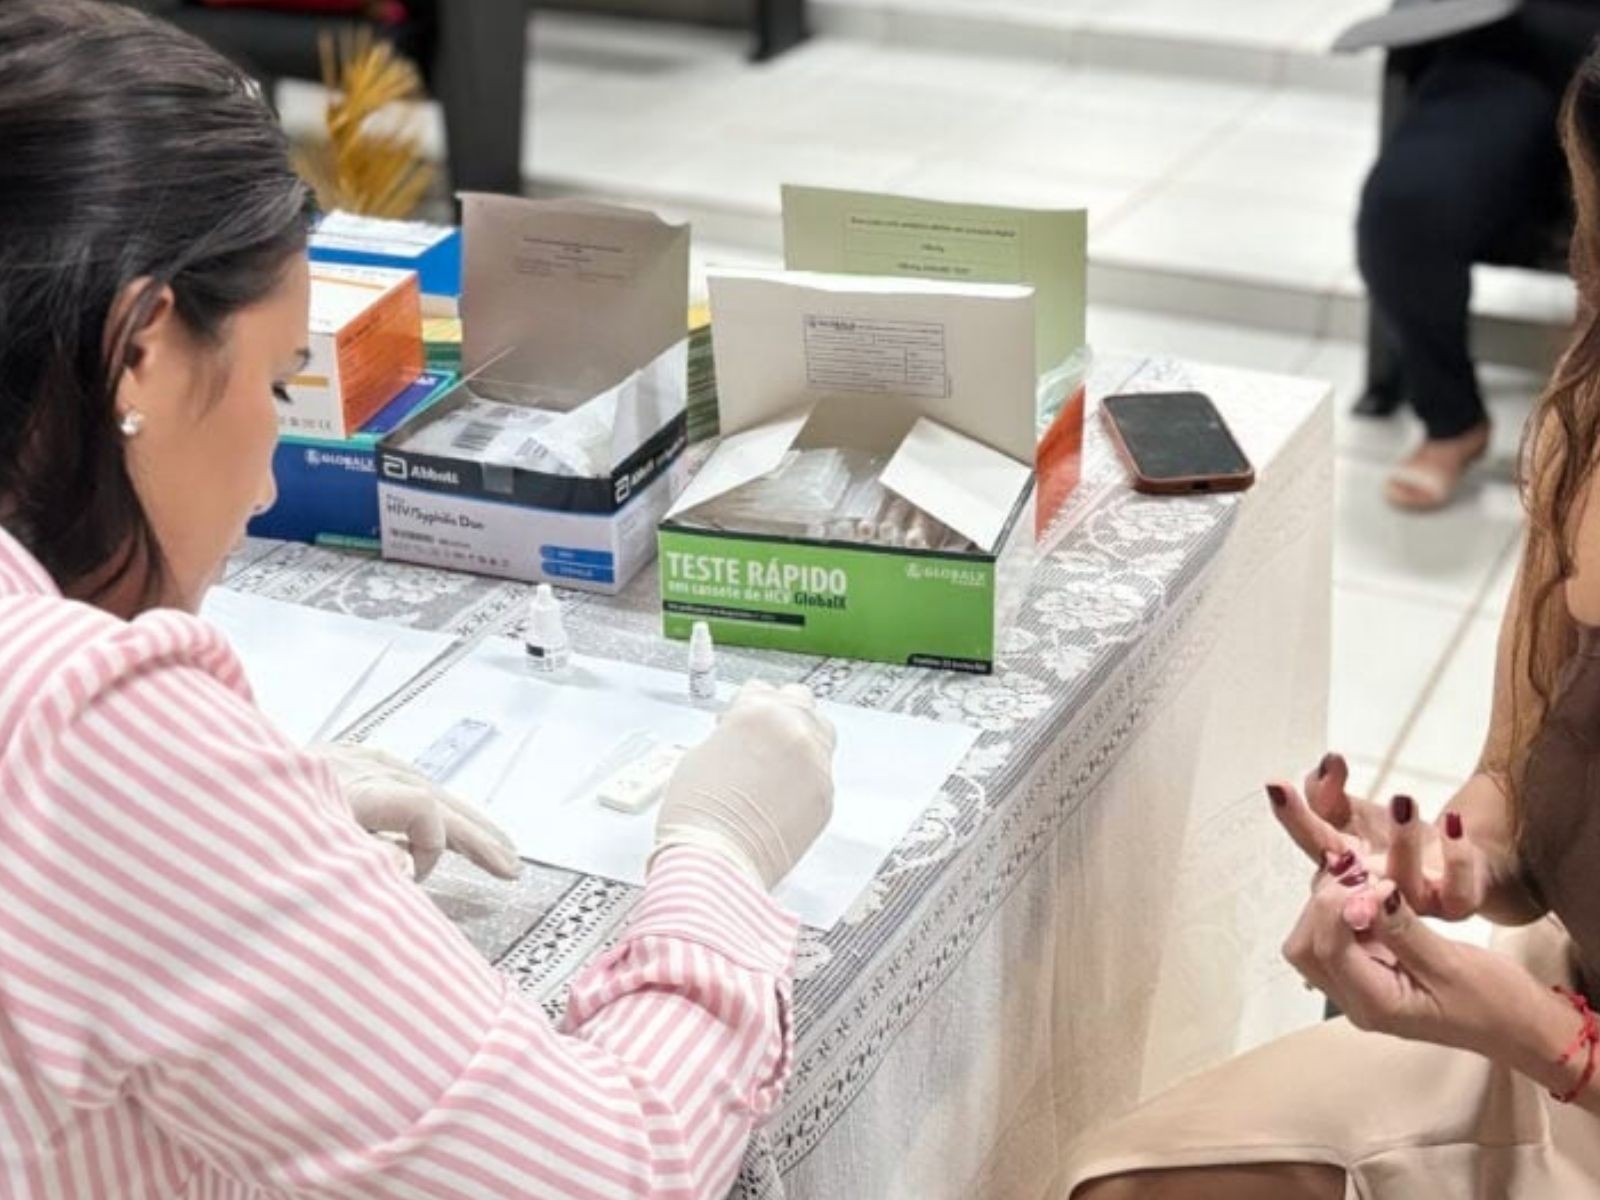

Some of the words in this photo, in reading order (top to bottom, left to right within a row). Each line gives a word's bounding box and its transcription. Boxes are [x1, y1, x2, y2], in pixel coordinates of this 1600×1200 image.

[411, 465, 460, 485] Abbott
[666, 551, 740, 585] TESTE
[748, 557, 847, 596] RÁPIDO
[794, 592, 847, 609] GlobalX
